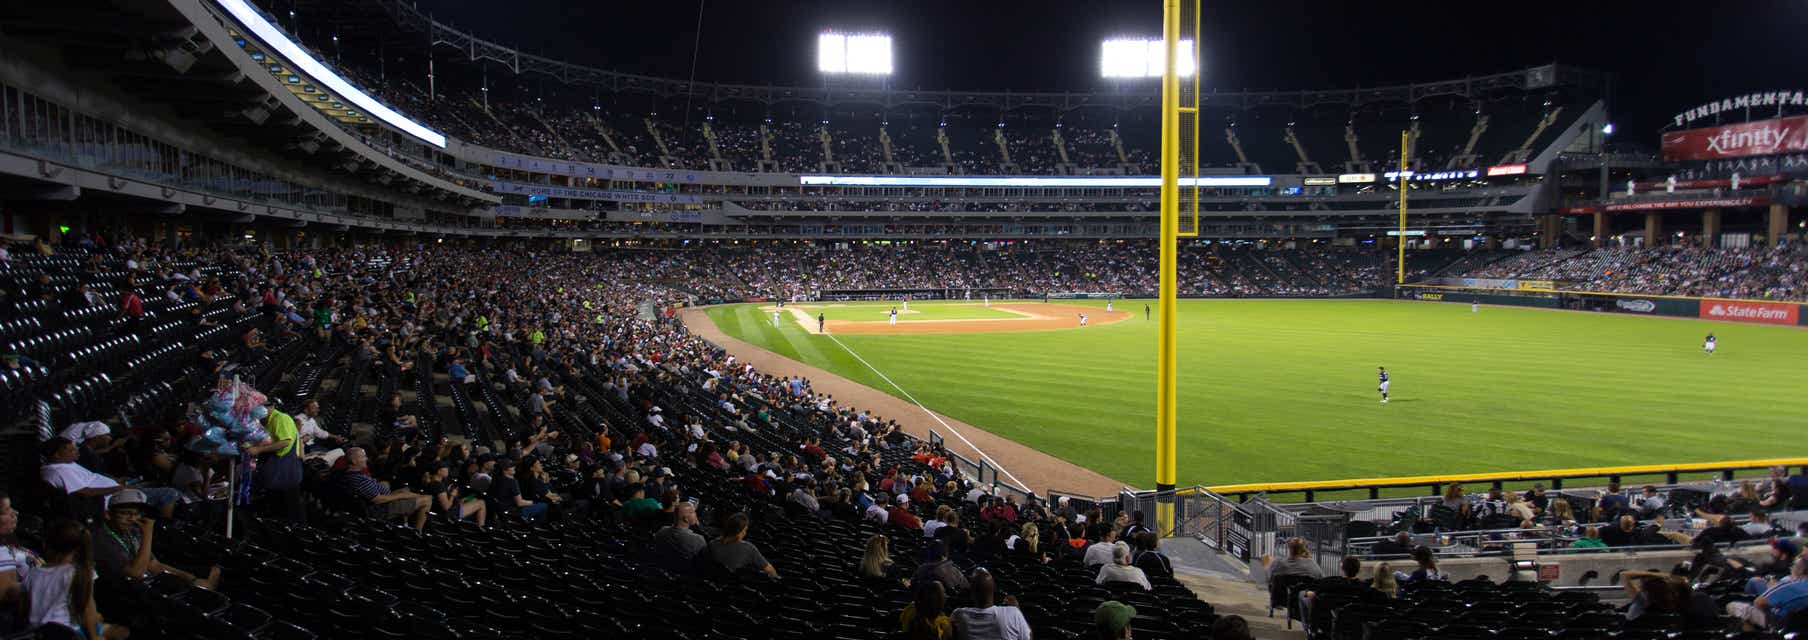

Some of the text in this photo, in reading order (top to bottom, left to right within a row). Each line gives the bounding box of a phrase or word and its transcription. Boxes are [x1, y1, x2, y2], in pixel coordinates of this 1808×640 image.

[1674, 91, 1808, 127] FUNDAMENTA
[1706, 125, 1790, 154] xfinity
[580, 190, 612, 199] CHICAGO
[614, 191, 640, 200] WHITE
[1680, 200, 1694, 208] YOU
